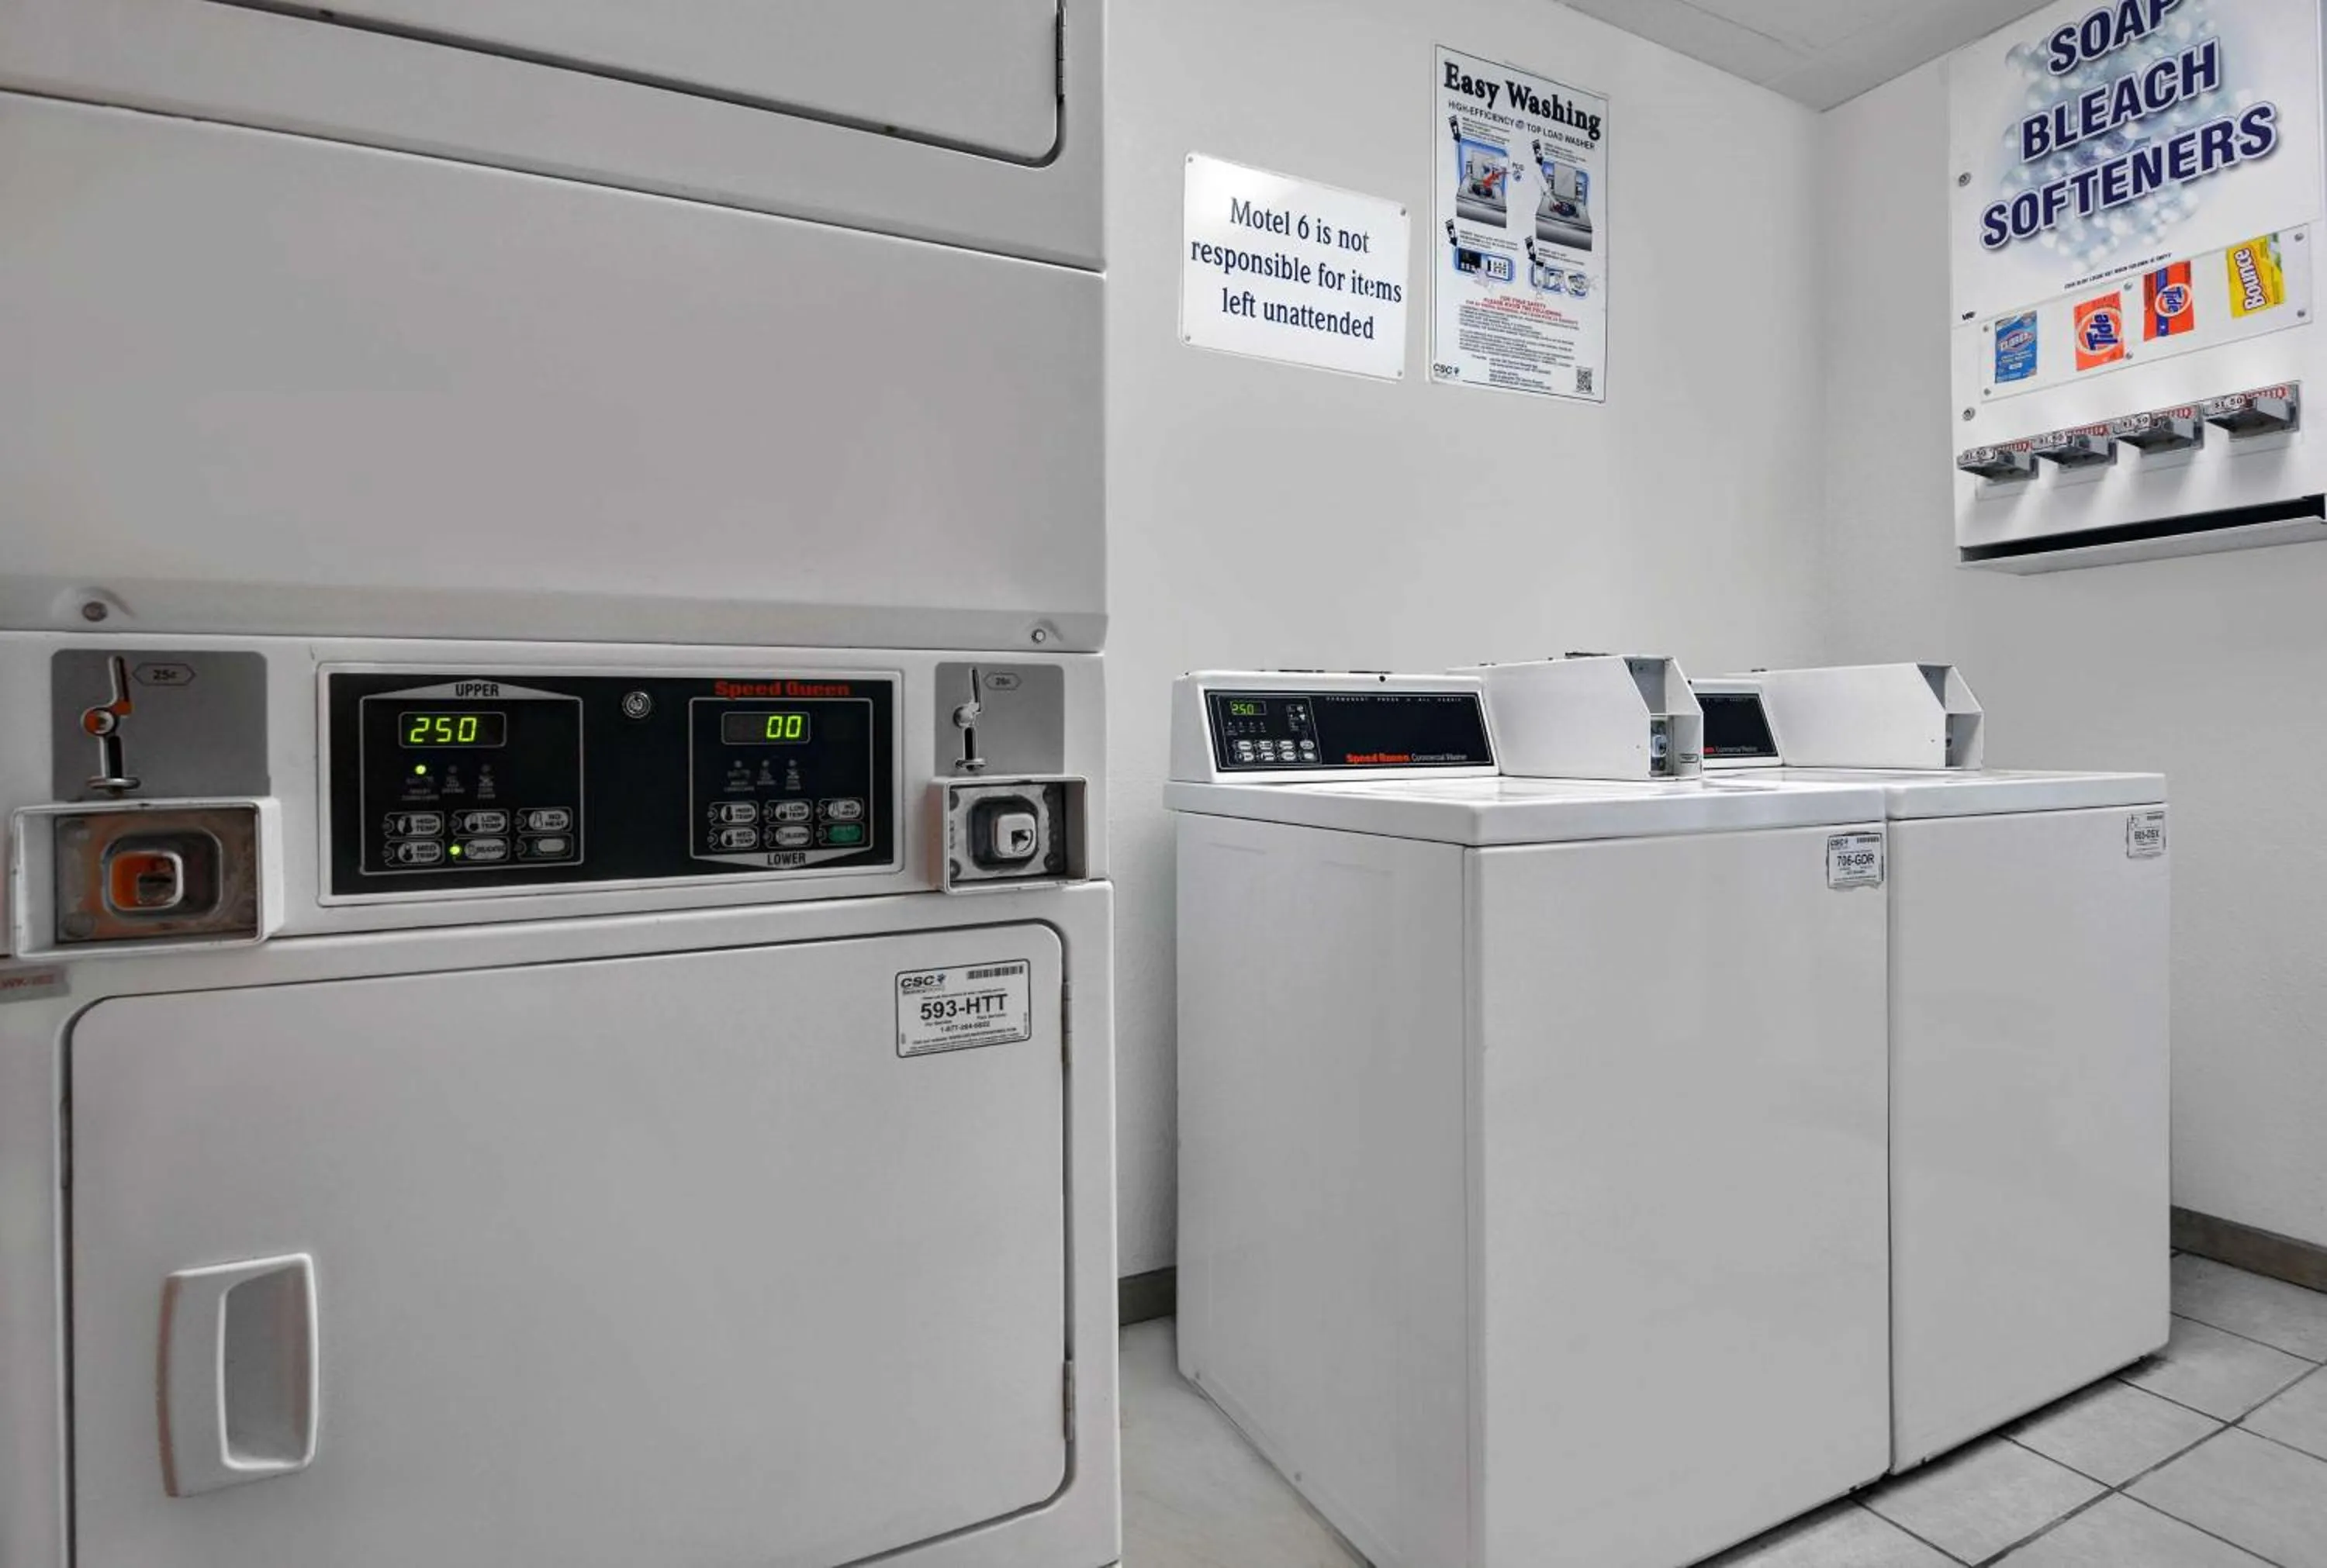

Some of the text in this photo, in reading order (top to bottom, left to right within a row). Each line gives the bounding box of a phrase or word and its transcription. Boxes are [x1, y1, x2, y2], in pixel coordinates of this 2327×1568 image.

[1444, 61, 1500, 110] Easy
[1505, 80, 1602, 141] Washing
[1448, 99, 1515, 127] HIGH-EFFICIENCY
[2021, 40, 2218, 161] BLEACH
[1527, 123, 1541, 133] TOP
[1982, 102, 2276, 248] SOFTENERS
[1229, 197, 1371, 254] Motel 6 is not
[1191, 240, 1402, 303] responsible for items
[2234, 247, 2266, 311] Bounce
[2163, 286, 2183, 312] Tide
[1222, 287, 1375, 340] left unattended
[2086, 313, 2119, 351] Tide
[2214, 397, 2243, 409] $1.50
[455, 683, 500, 697] UPPER
[714, 681, 850, 699] Speed Queen
[1231, 703, 1254, 714] 250
[410, 717, 478, 743] 250
[766, 715, 802, 738] 00
[766, 853, 806, 866] LOWER
[901, 975, 935, 989] CSC
[920, 993, 1008, 1021] 593-HTT
